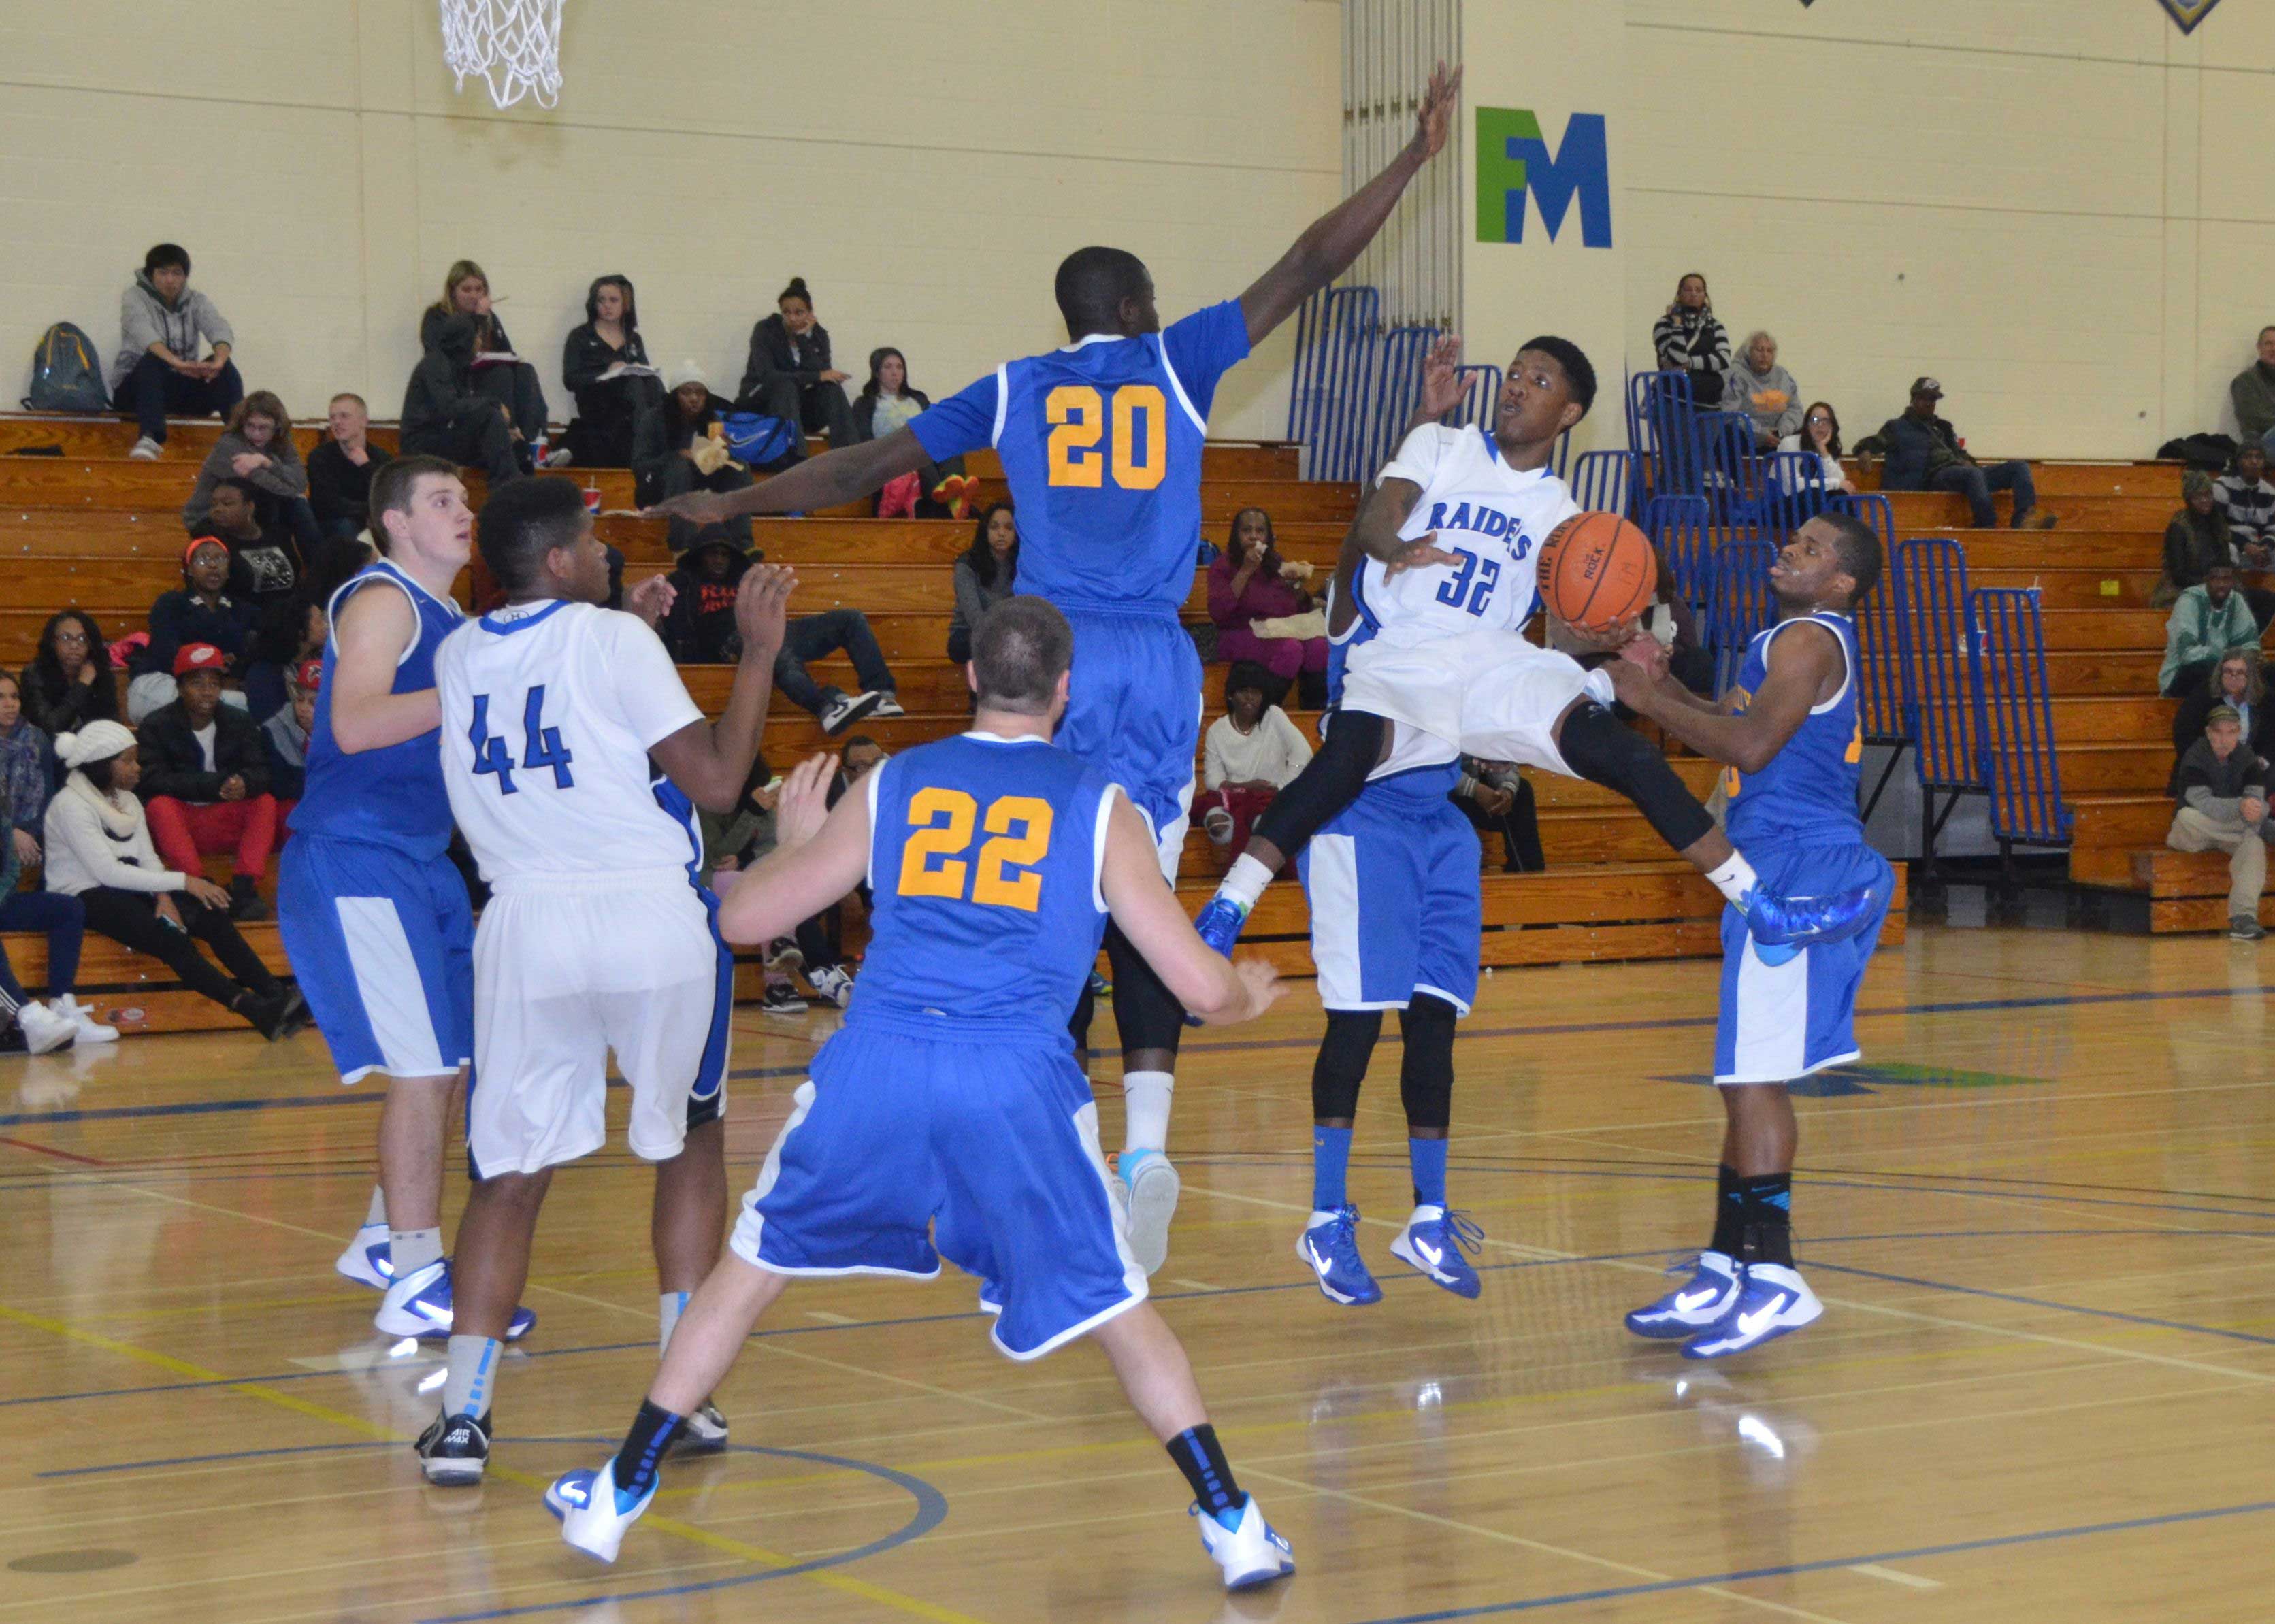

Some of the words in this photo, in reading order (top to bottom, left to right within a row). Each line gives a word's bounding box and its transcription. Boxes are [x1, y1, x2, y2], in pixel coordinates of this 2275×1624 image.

[1475, 106, 1613, 250] FM
[1046, 385, 1166, 490] 20
[1435, 546, 1501, 617] 32
[1537, 554, 1552, 591] THE
[1584, 546, 1605, 580] ROCK
[468, 684, 574, 795] 44
[897, 786, 1054, 913] 22
[443, 1436, 469, 1444] MAX
[451, 1428, 471, 1436] AIR
